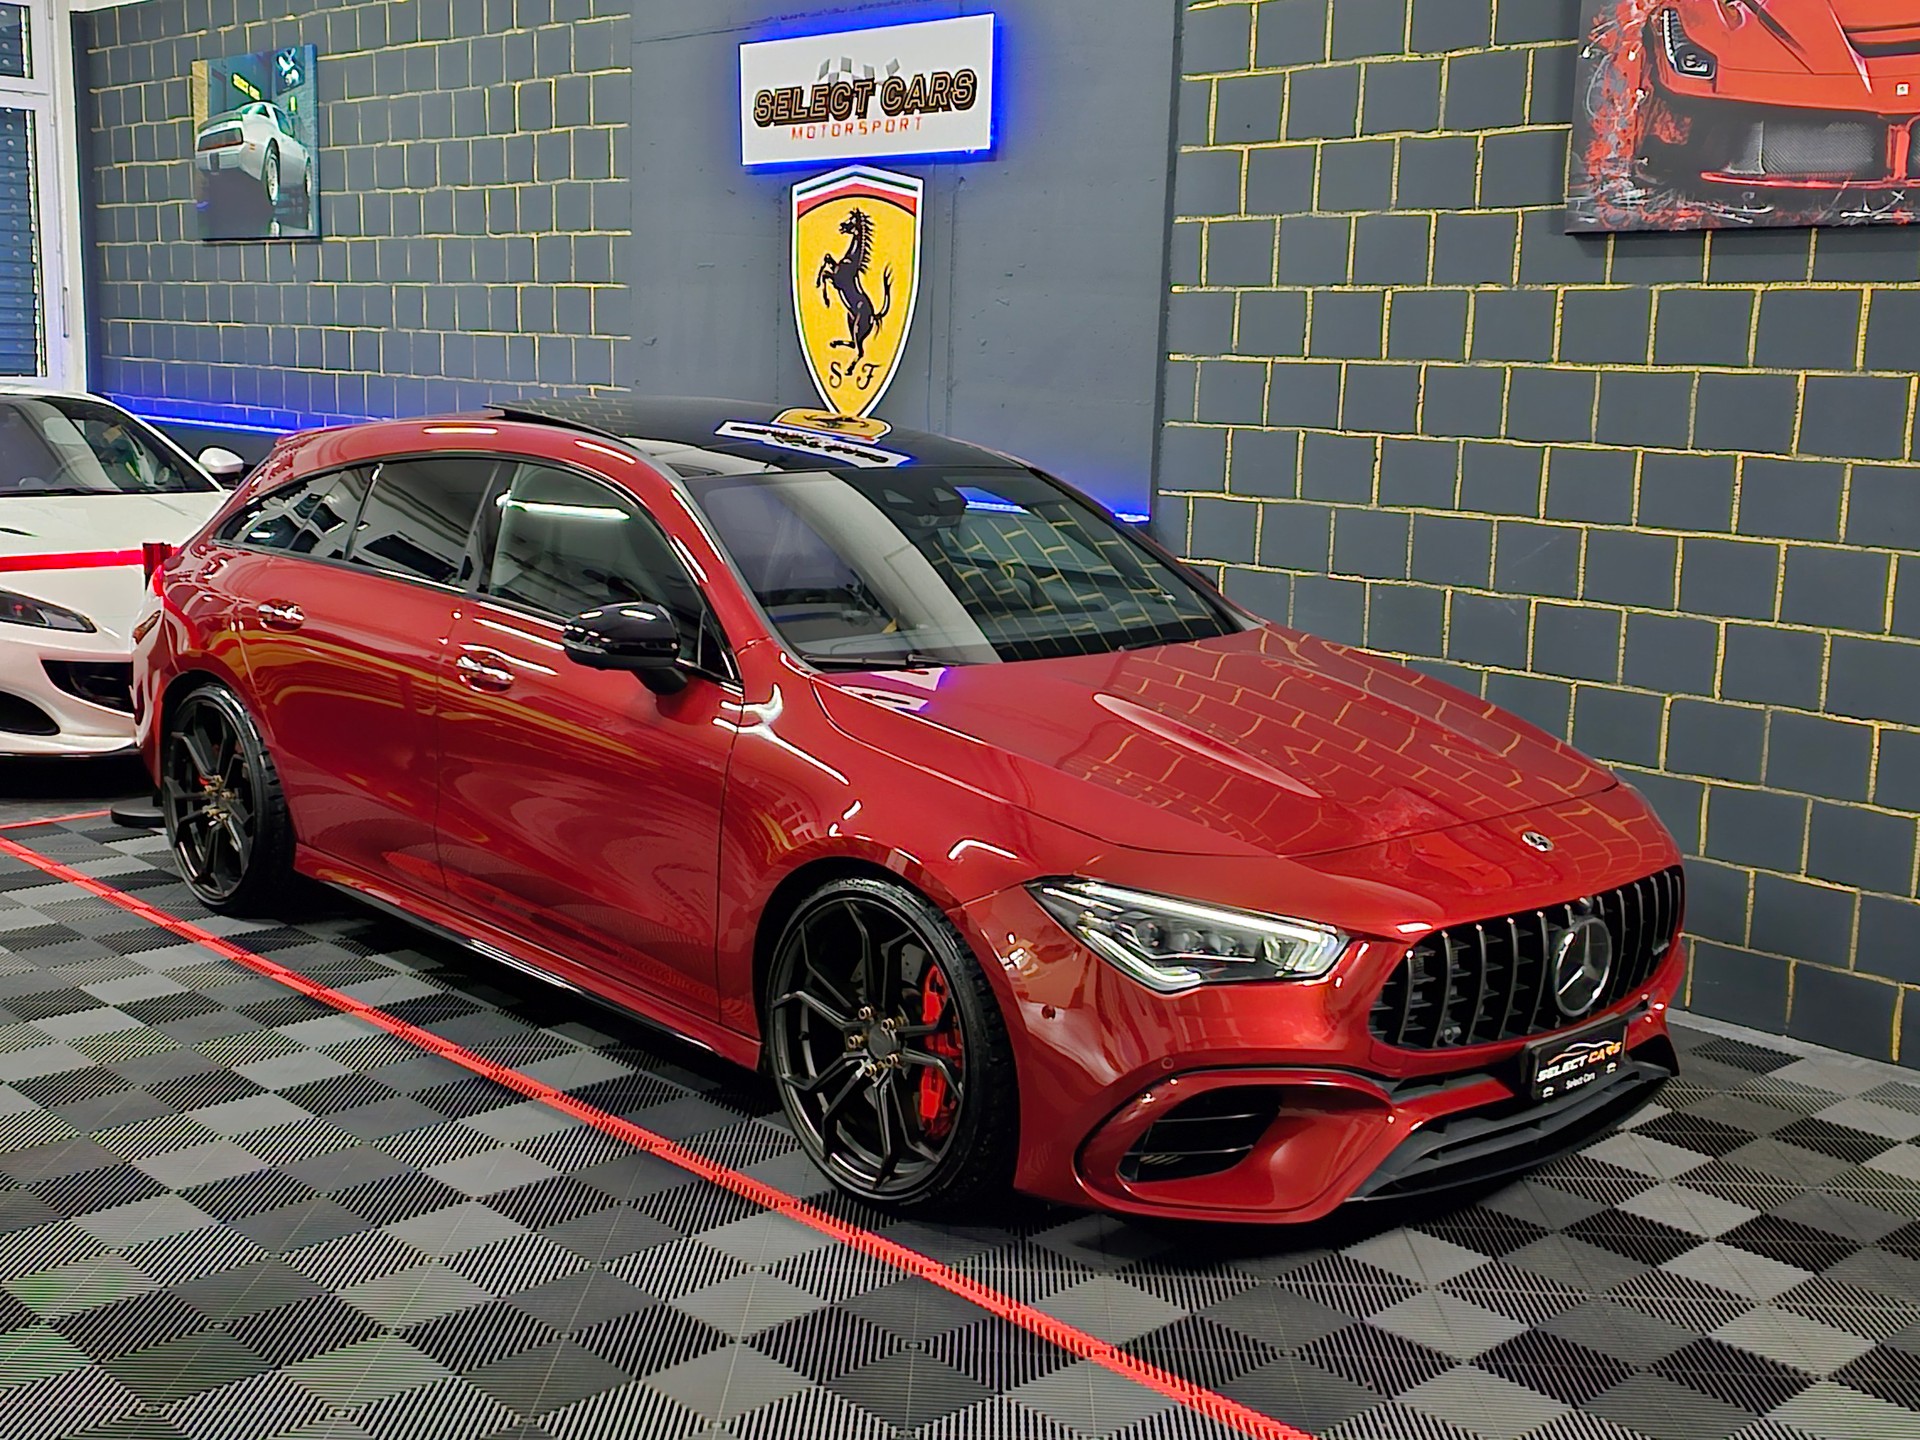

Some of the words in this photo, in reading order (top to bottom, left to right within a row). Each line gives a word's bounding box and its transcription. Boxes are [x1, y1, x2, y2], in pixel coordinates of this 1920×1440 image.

[754, 78, 875, 127] SELECT
[880, 69, 977, 117] CARS
[791, 117, 922, 140] MOTORSPORT
[829, 361, 842, 388] S
[1536, 1054, 1588, 1082] SELECT
